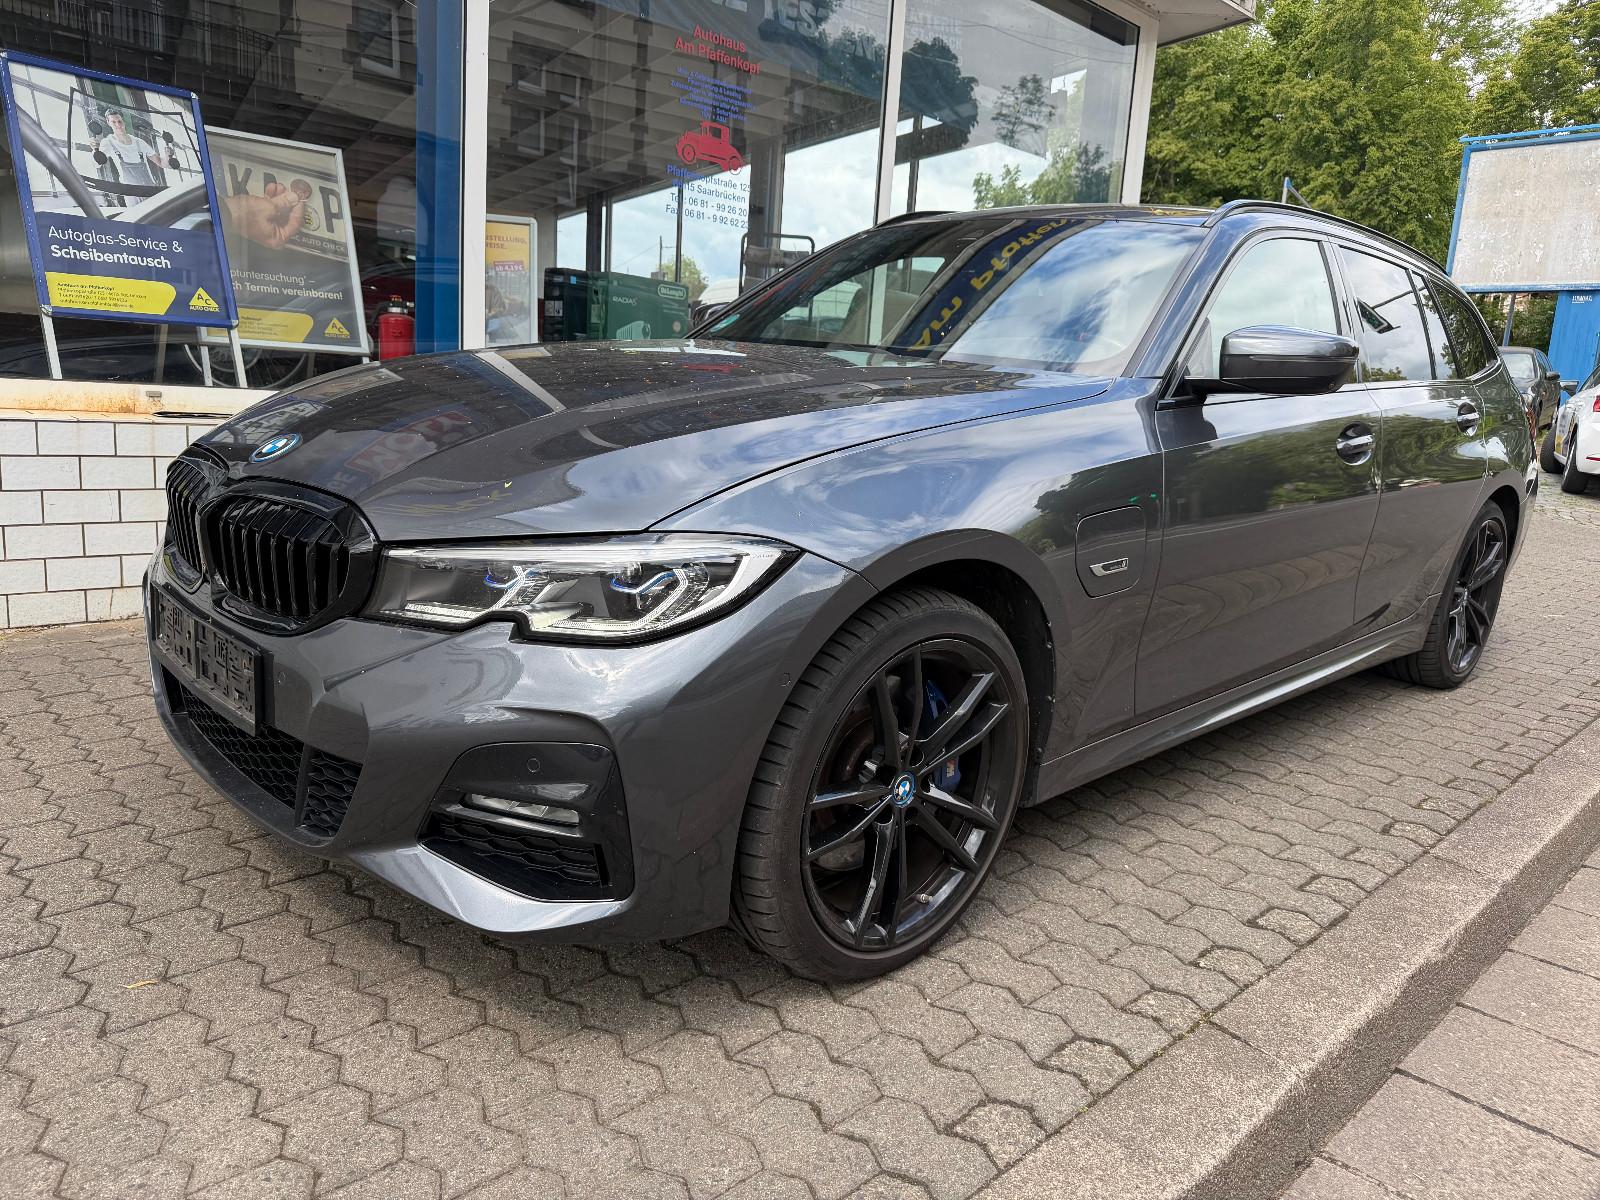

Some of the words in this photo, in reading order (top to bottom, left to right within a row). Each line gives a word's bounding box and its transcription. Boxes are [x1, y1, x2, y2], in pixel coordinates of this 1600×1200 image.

[693, 24, 747, 53] Autohaus
[675, 37, 695, 54] Am
[698, 43, 761, 74] Pfaffenkopf
[697, 185, 746, 203] Saarbrücken
[685, 208, 695, 217] 06
[696, 210, 705, 219] 81
[689, 197, 698, 206] 06
[701, 200, 708, 208] 81
[717, 203, 726, 212] 99
[728, 205, 737, 215] 26
[738, 208, 748, 217] 20
[49, 226, 168, 251] Autoglas-Service
[172, 241, 183, 253] &
[50, 244, 171, 269] Scheibentausch
[231, 269, 307, 286] ptuntersuchung
[246, 282, 279, 294] Termin
[281, 287, 343, 301] vereinbaren!
